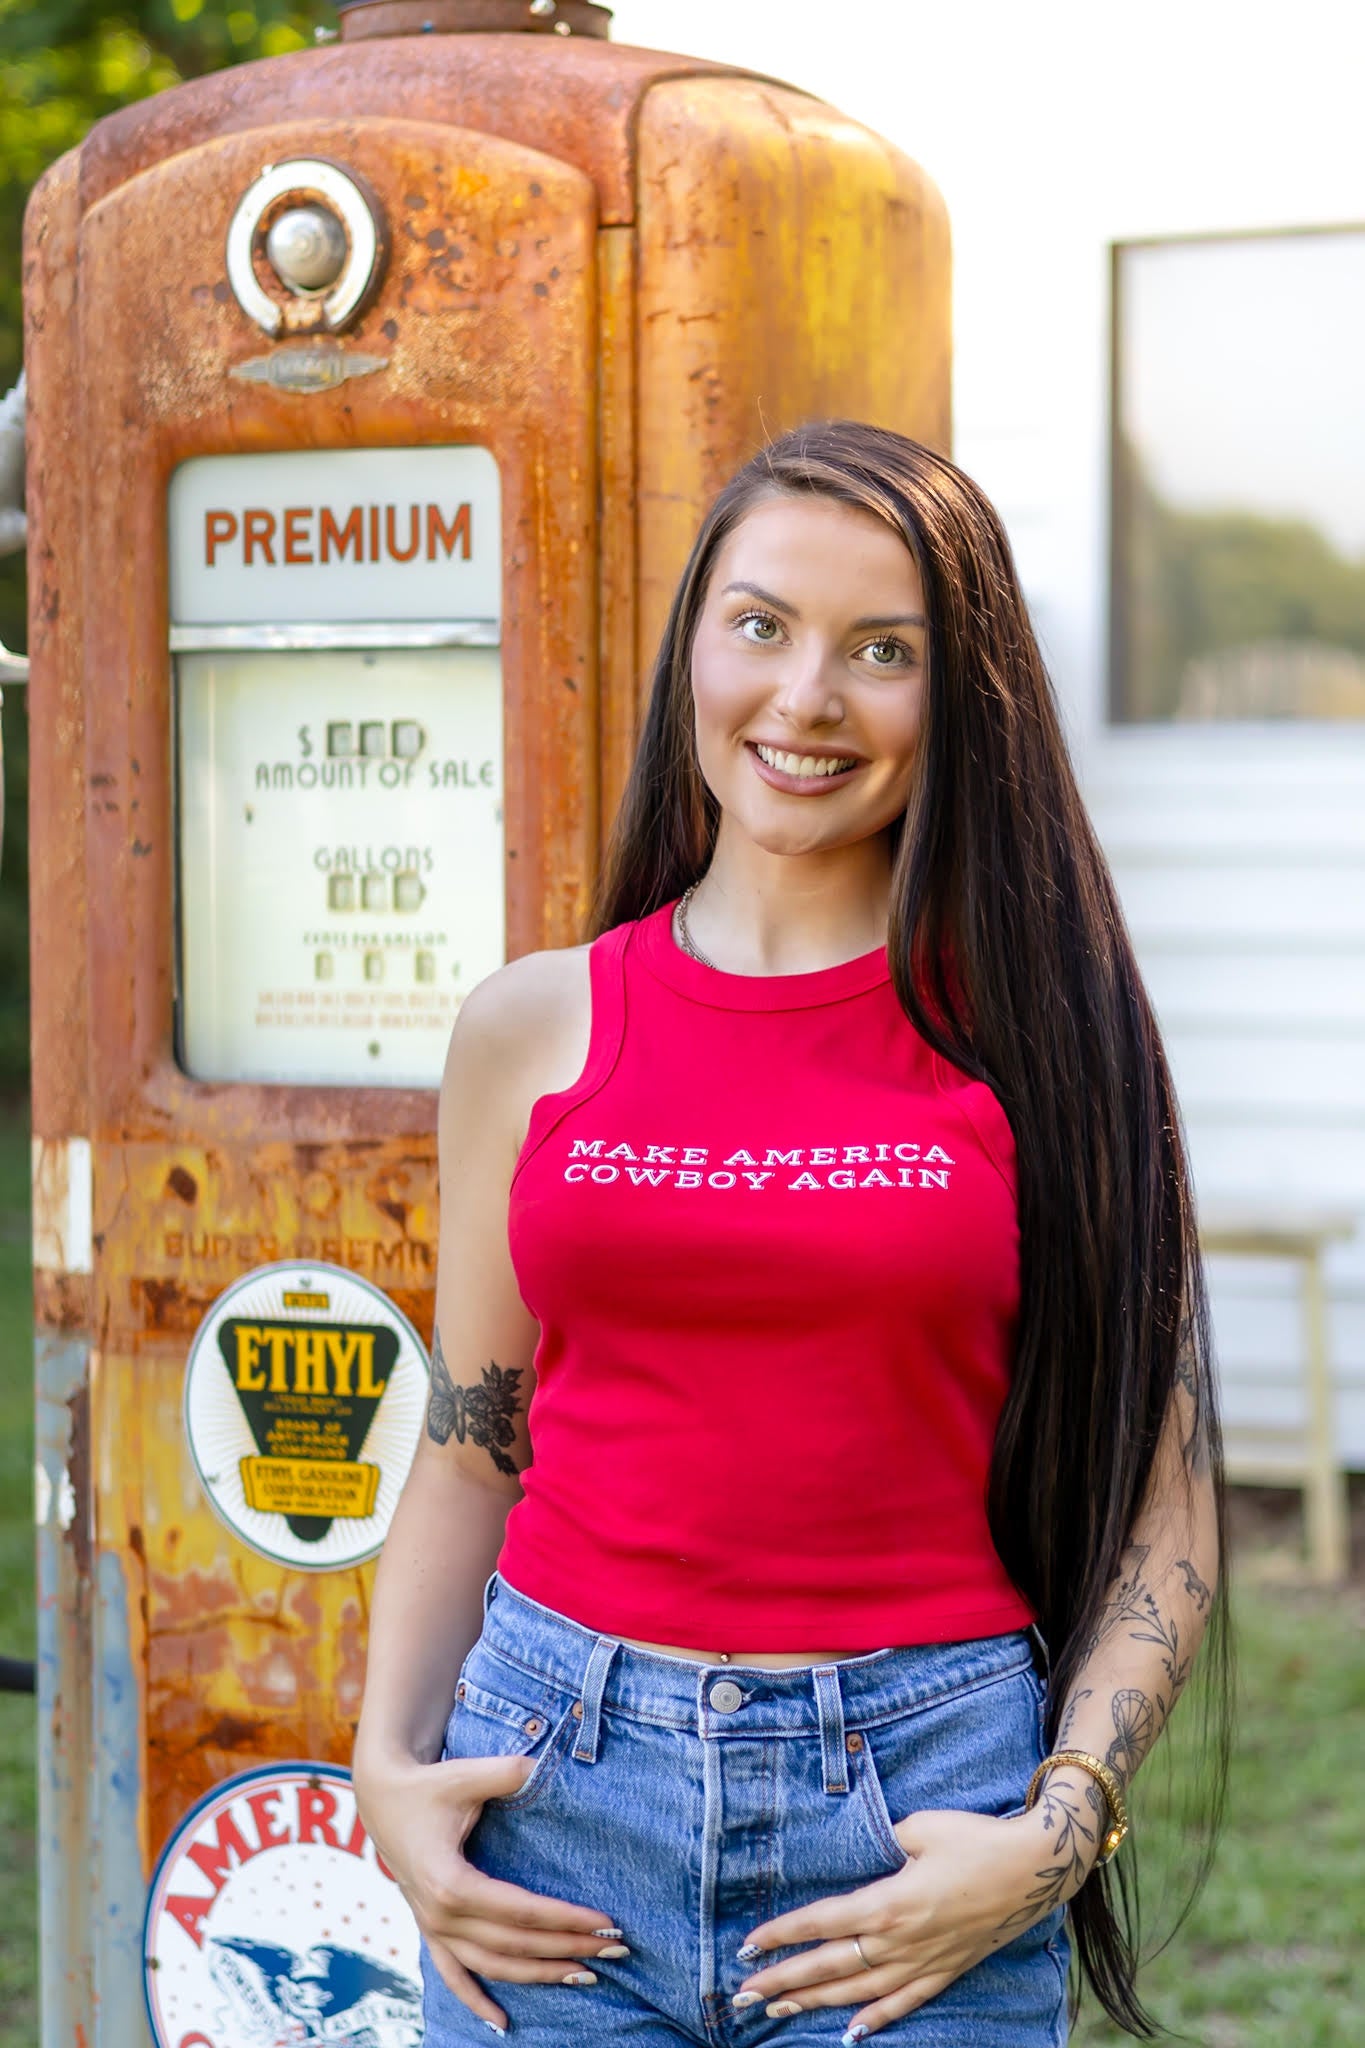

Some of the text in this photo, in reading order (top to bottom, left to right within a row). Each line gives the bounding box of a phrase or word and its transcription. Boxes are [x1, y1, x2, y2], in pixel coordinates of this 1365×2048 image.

[205, 503, 471, 566] PREMIUM
[256, 760, 496, 790] AMOUNT OF SALE
[313, 847, 434, 873] GALLONS
[568, 1140, 957, 1166] MAKE AMERICA
[563, 1163, 952, 1191] COWBOY AGAIN
[234, 1326, 385, 1398] ETHYL
[299, 1467, 363, 1484] GASOLINE
[263, 1483, 357, 1500] CORPORATION
